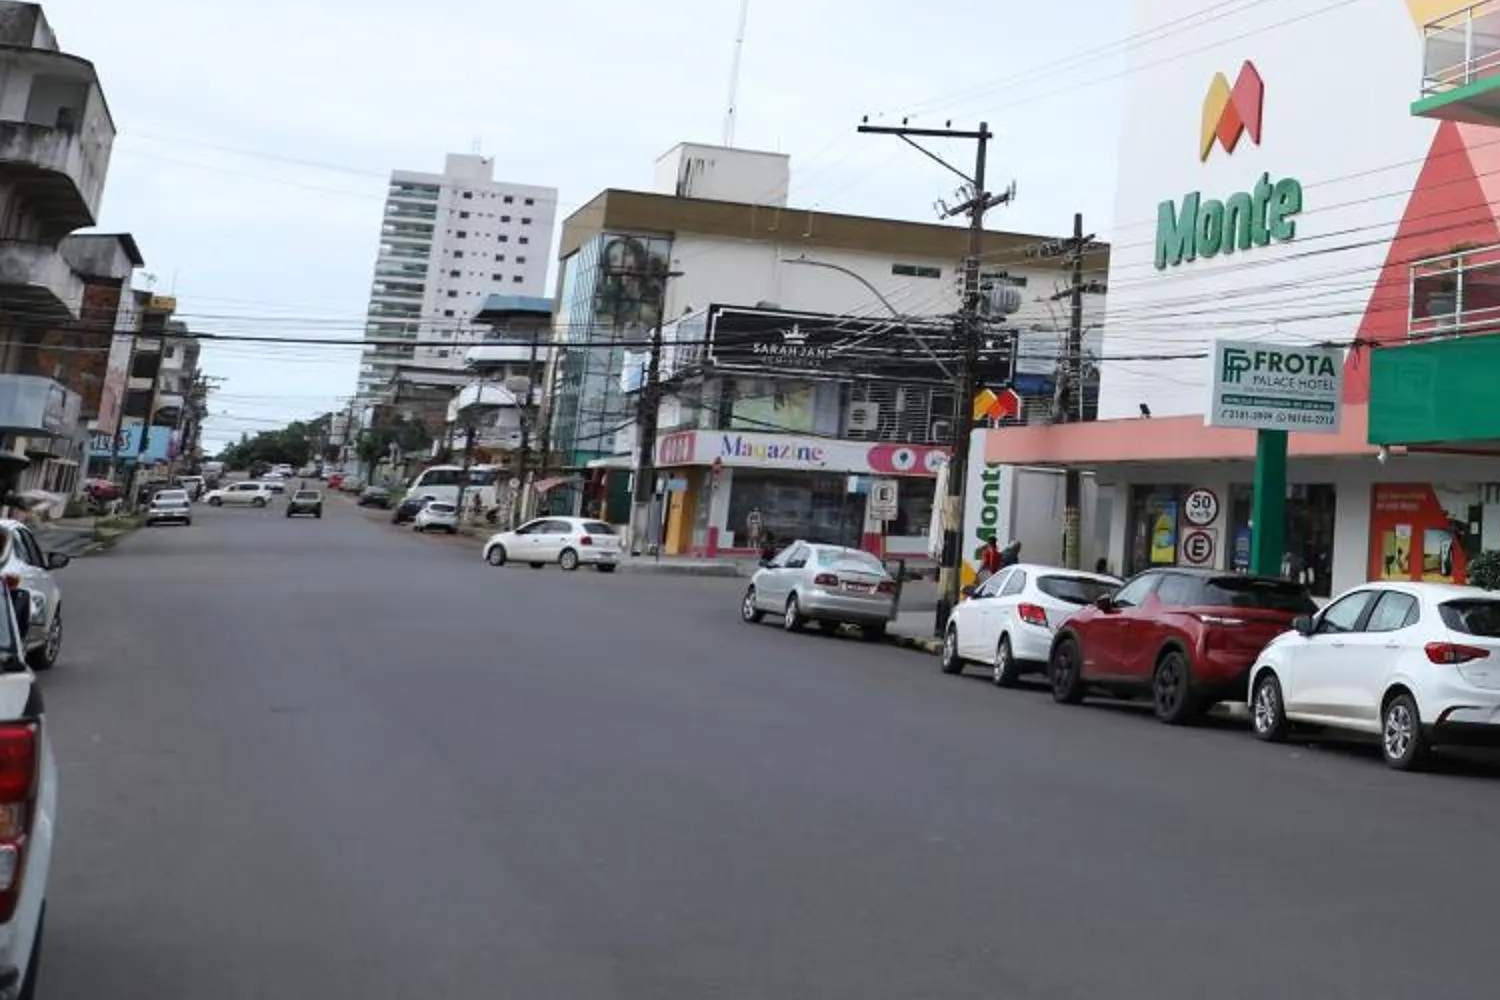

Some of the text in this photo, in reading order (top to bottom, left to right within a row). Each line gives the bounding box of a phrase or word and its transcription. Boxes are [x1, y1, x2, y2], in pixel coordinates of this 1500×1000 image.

[1154, 171, 1303, 271] Monte
[1254, 350, 1336, 377] FROTA
[1253, 375, 1335, 391] PALACE HOTEL
[720, 435, 824, 461] Magazine
[974, 463, 1001, 561] Mont
[1191, 494, 1211, 509] 50
[1192, 538, 1205, 556] E
